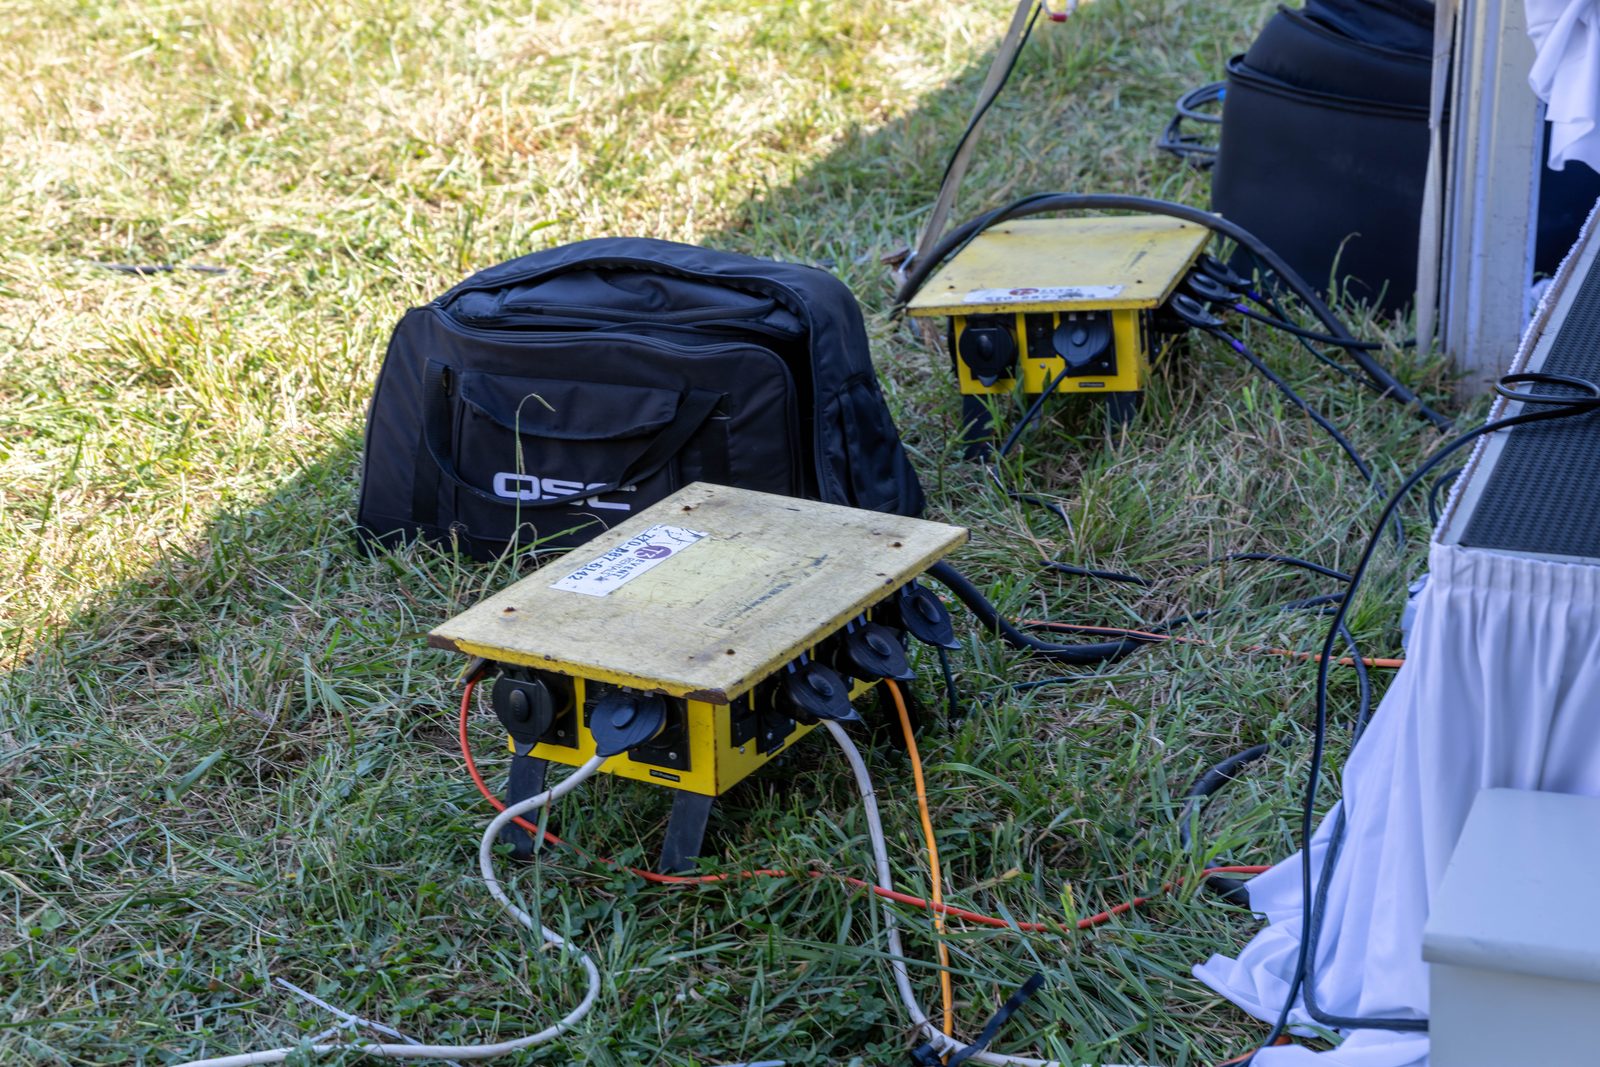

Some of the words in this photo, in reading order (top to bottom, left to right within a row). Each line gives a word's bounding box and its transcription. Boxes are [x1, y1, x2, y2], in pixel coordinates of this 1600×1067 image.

[493, 472, 632, 511] QSC
[634, 547, 665, 559] T3
[611, 559, 646, 578] EVENT
